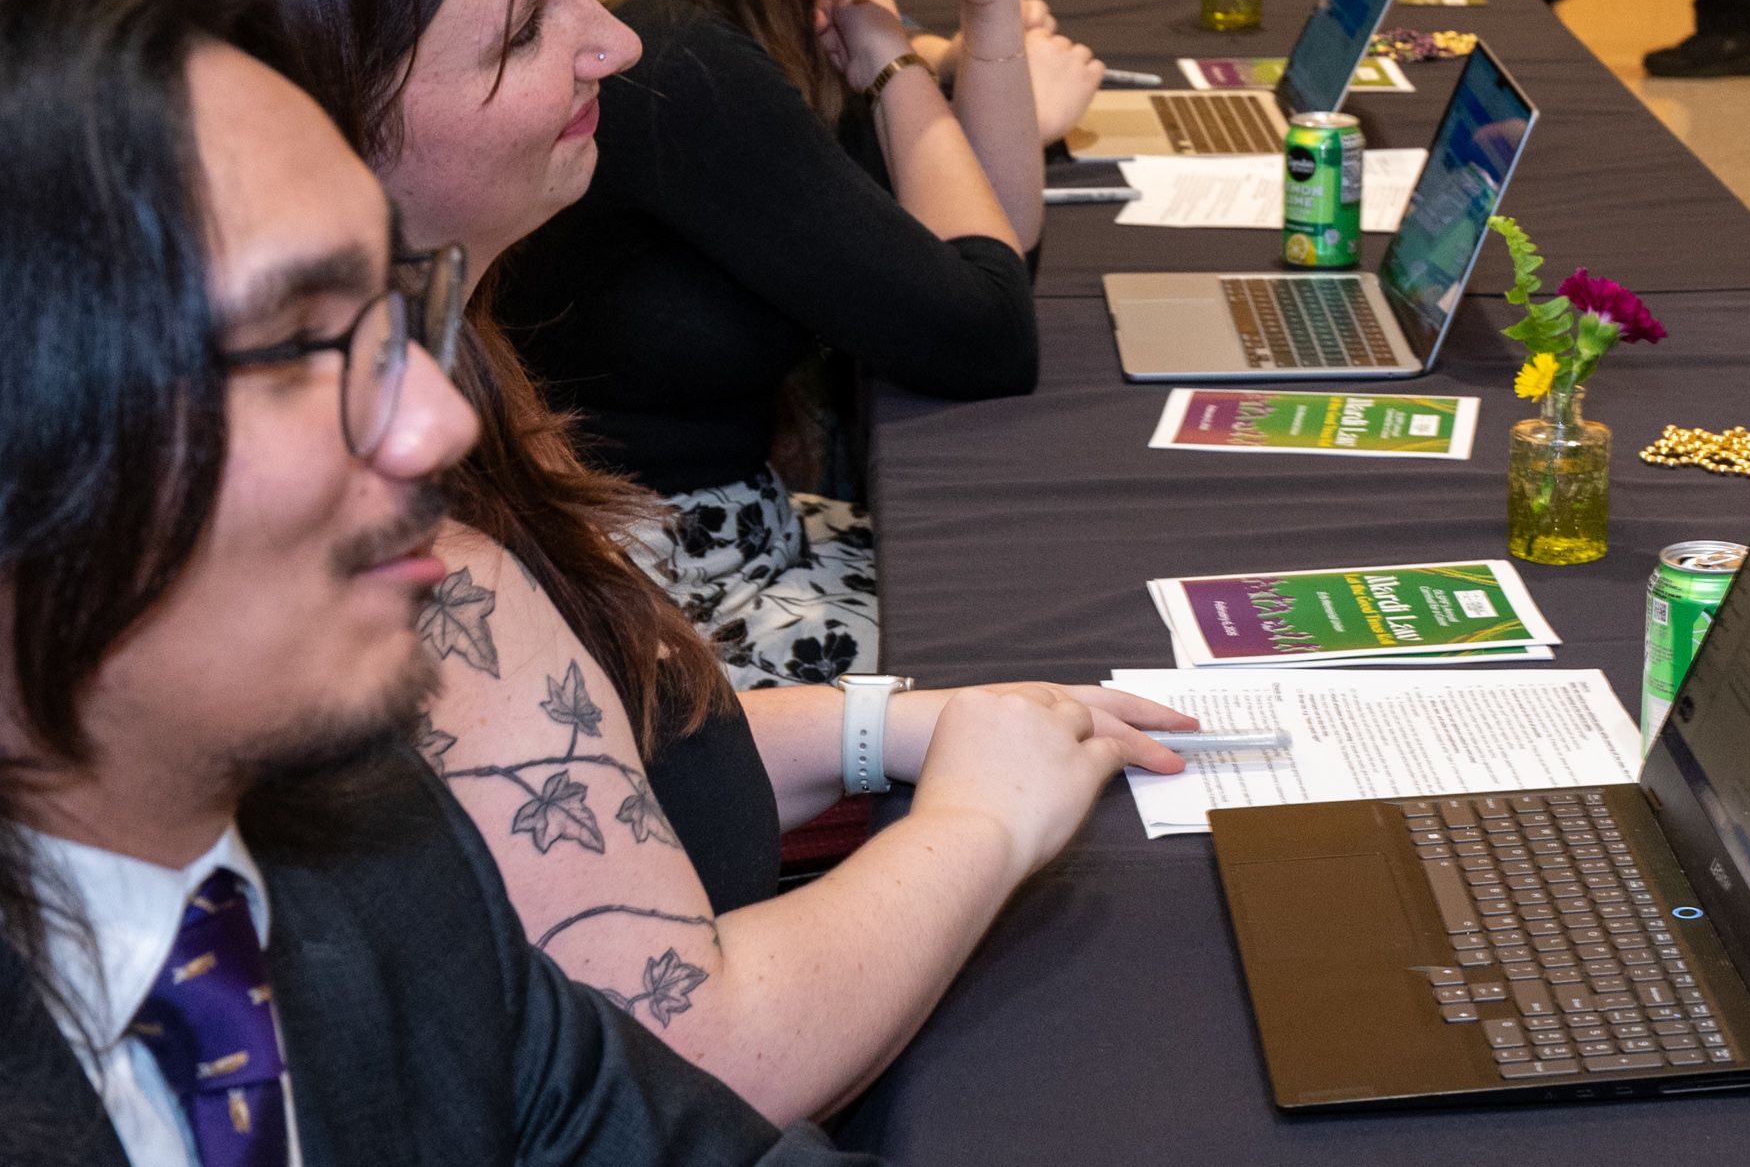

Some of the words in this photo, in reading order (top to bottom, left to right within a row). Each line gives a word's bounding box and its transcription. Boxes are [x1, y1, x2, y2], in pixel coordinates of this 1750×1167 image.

[1356, 595, 1378, 614] Good
[1364, 575, 1412, 612] Mardi
[1385, 615, 1424, 641] Law
